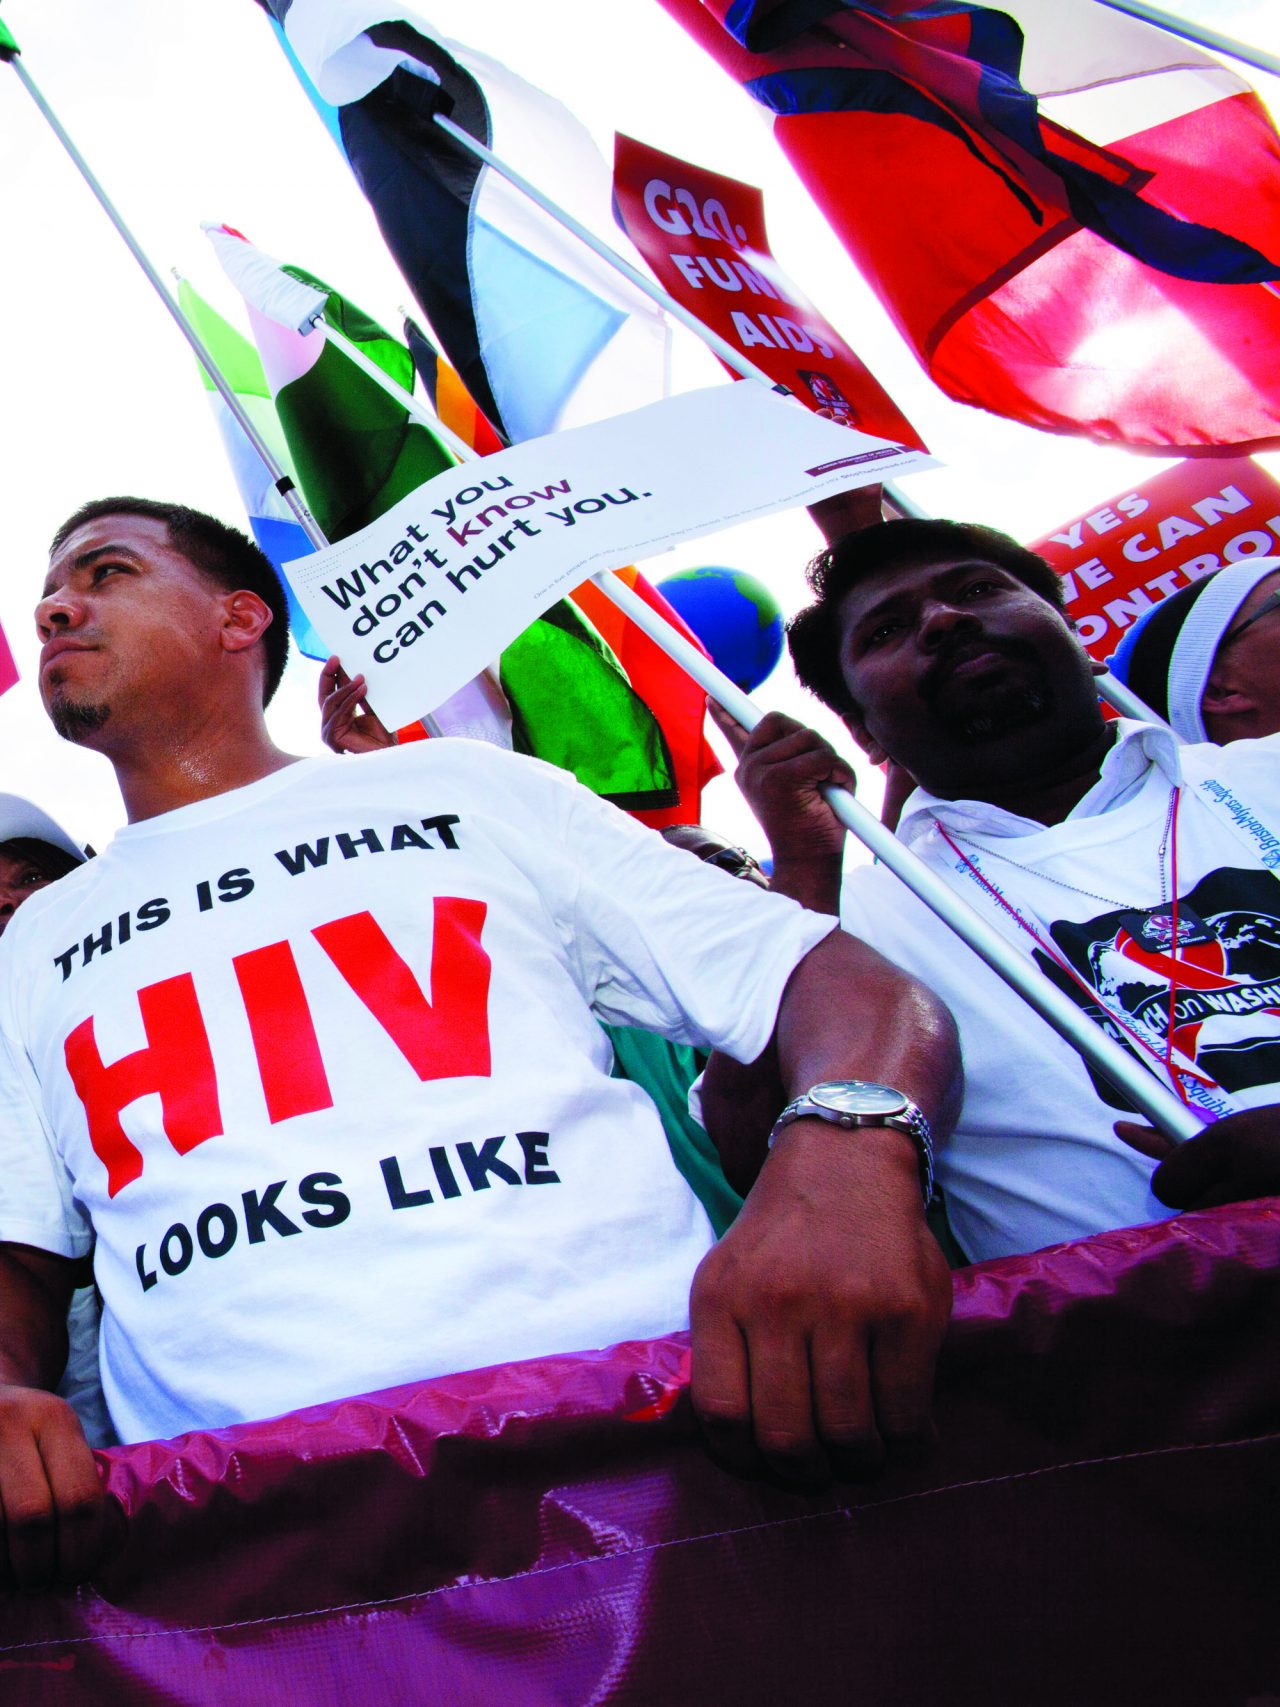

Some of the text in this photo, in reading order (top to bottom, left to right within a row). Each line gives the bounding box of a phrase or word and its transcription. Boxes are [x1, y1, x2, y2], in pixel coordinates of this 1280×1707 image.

[670, 253, 783, 301] FUN
[320, 475, 515, 611] What you
[352, 478, 572, 637] don't know
[373, 599, 447, 664] can
[444, 518, 542, 594] hurt
[545, 487, 653, 527] you.
[1048, 492, 1151, 550] YES
[1072, 515, 1280, 647] ONTRO
[1122, 484, 1254, 563] CAN
[1200, 779, 1233, 803] Squibb
[53, 813, 461, 983] THIS IS WHAT
[64, 896, 492, 1200] HIV
[1174, 998, 1205, 1020] on
[135, 1131, 562, 1293] LOOKS LIKE
